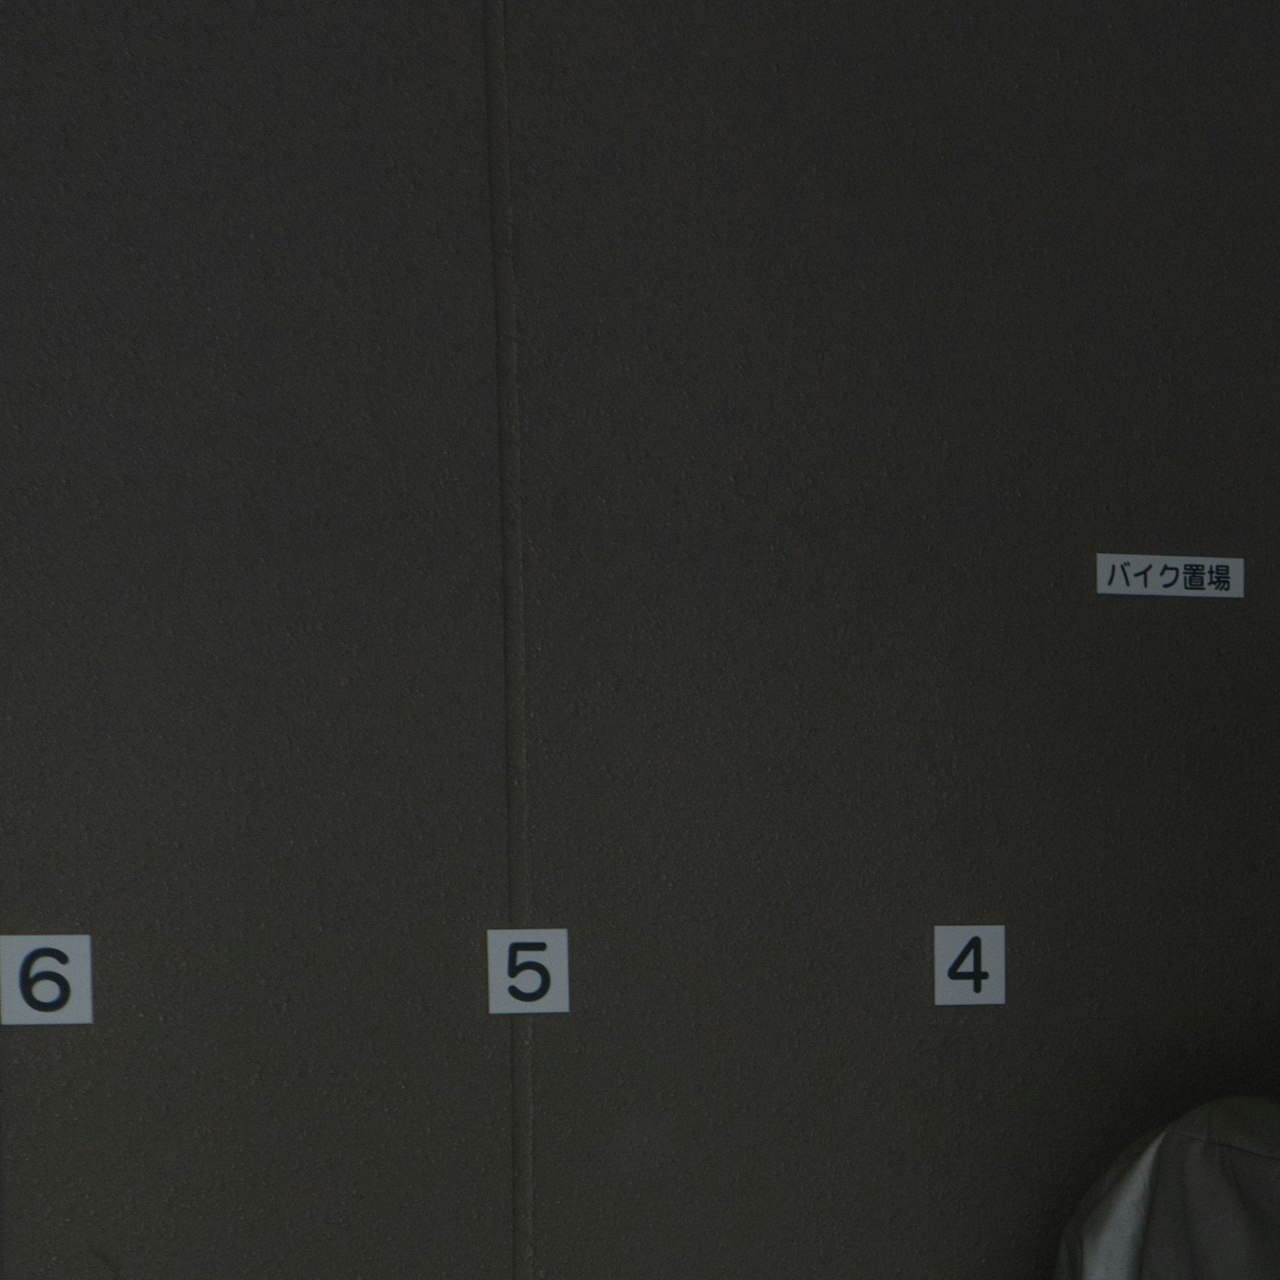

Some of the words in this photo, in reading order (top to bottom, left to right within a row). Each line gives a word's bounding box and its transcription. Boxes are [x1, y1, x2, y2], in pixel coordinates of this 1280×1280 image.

[1107, 561, 1231, 591] バイク置場
[19, 948, 70, 1012] 6
[508, 942, 550, 1002] 5
[948, 936, 989, 993] 4
